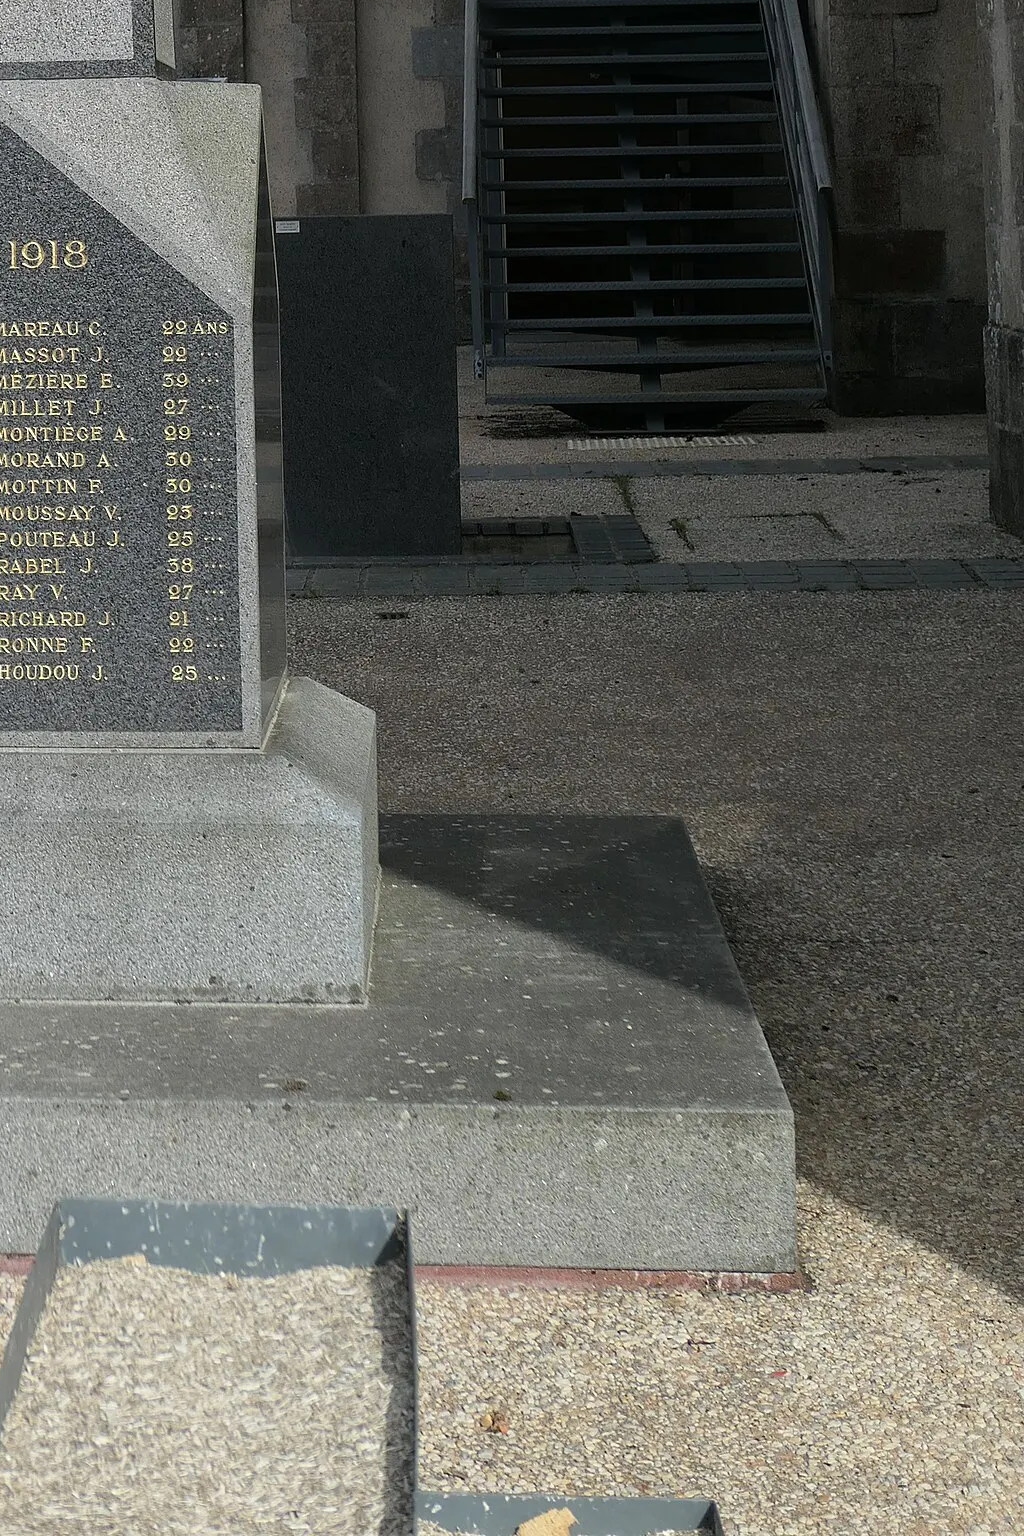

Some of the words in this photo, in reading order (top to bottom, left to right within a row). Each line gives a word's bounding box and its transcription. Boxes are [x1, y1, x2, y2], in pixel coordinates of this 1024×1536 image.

[8, 240, 88, 269] 1918
[88, 322, 107, 336] C.
[163, 321, 187, 335] 22
[192, 321, 227, 335] ANS
[91, 347, 110, 363] J.
[163, 347, 187, 361] 22
[100, 374, 121, 388] E.
[163, 373, 188, 387] 39
[89, 400, 108, 415] J.
[164, 400, 189, 414] 27
[113, 427, 135, 441] A.
[164, 426, 190, 440] 29
[97, 453, 118, 467] A.
[165, 452, 192, 467] 30
[88, 480, 104, 493] F.
[165, 479, 191, 493] 30
[104, 506, 122, 520] V.
[167, 505, 193, 520] 23
[107, 531, 125, 546] J.
[168, 532, 194, 546] 25
[80, 559, 98, 574] J.
[167, 558, 194, 573] 38
[50, 585, 68, 600] V.
[168, 585, 193, 600] 27
[98, 612, 115, 626] J.
[169, 611, 189, 626] 21
[80, 638, 96, 653] F.
[169, 638, 194, 653] 22
[92, 666, 108, 680] J.
[172, 666, 198, 680] 25
